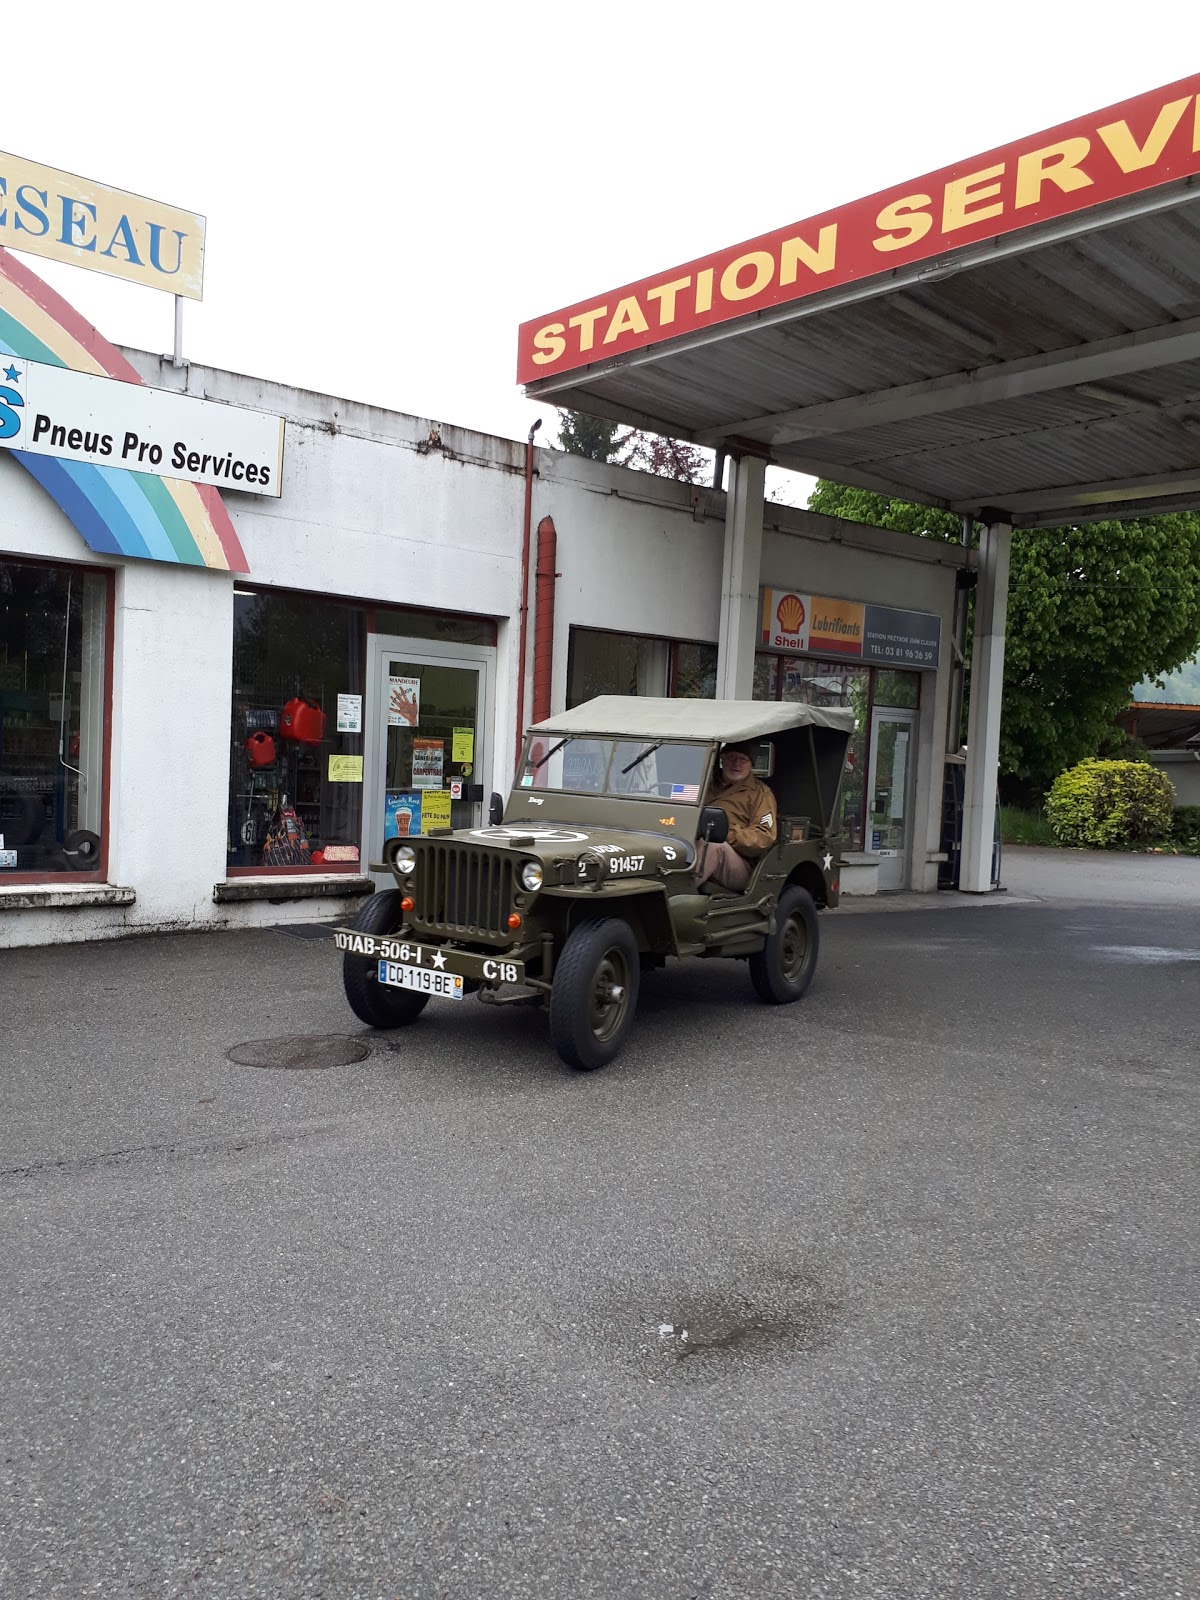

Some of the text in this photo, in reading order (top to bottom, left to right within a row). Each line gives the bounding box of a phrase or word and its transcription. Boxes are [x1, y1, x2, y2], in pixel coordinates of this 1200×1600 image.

[0, 177, 188, 274] SEAU
[531, 223, 837, 366] STATION
[32, 414, 271, 486] Pneus Pro Services
[812, 614, 860, 636] Lubrifiants
[774, 635, 804, 649] Shell
[871, 645, 932, 660] TEL: 03 81 96 26 59
[662, 845, 677, 861] S
[609, 855, 645, 874] 91457
[388, 964, 451, 995] CQ-119-BE
[482, 960, 518, 982] C18
